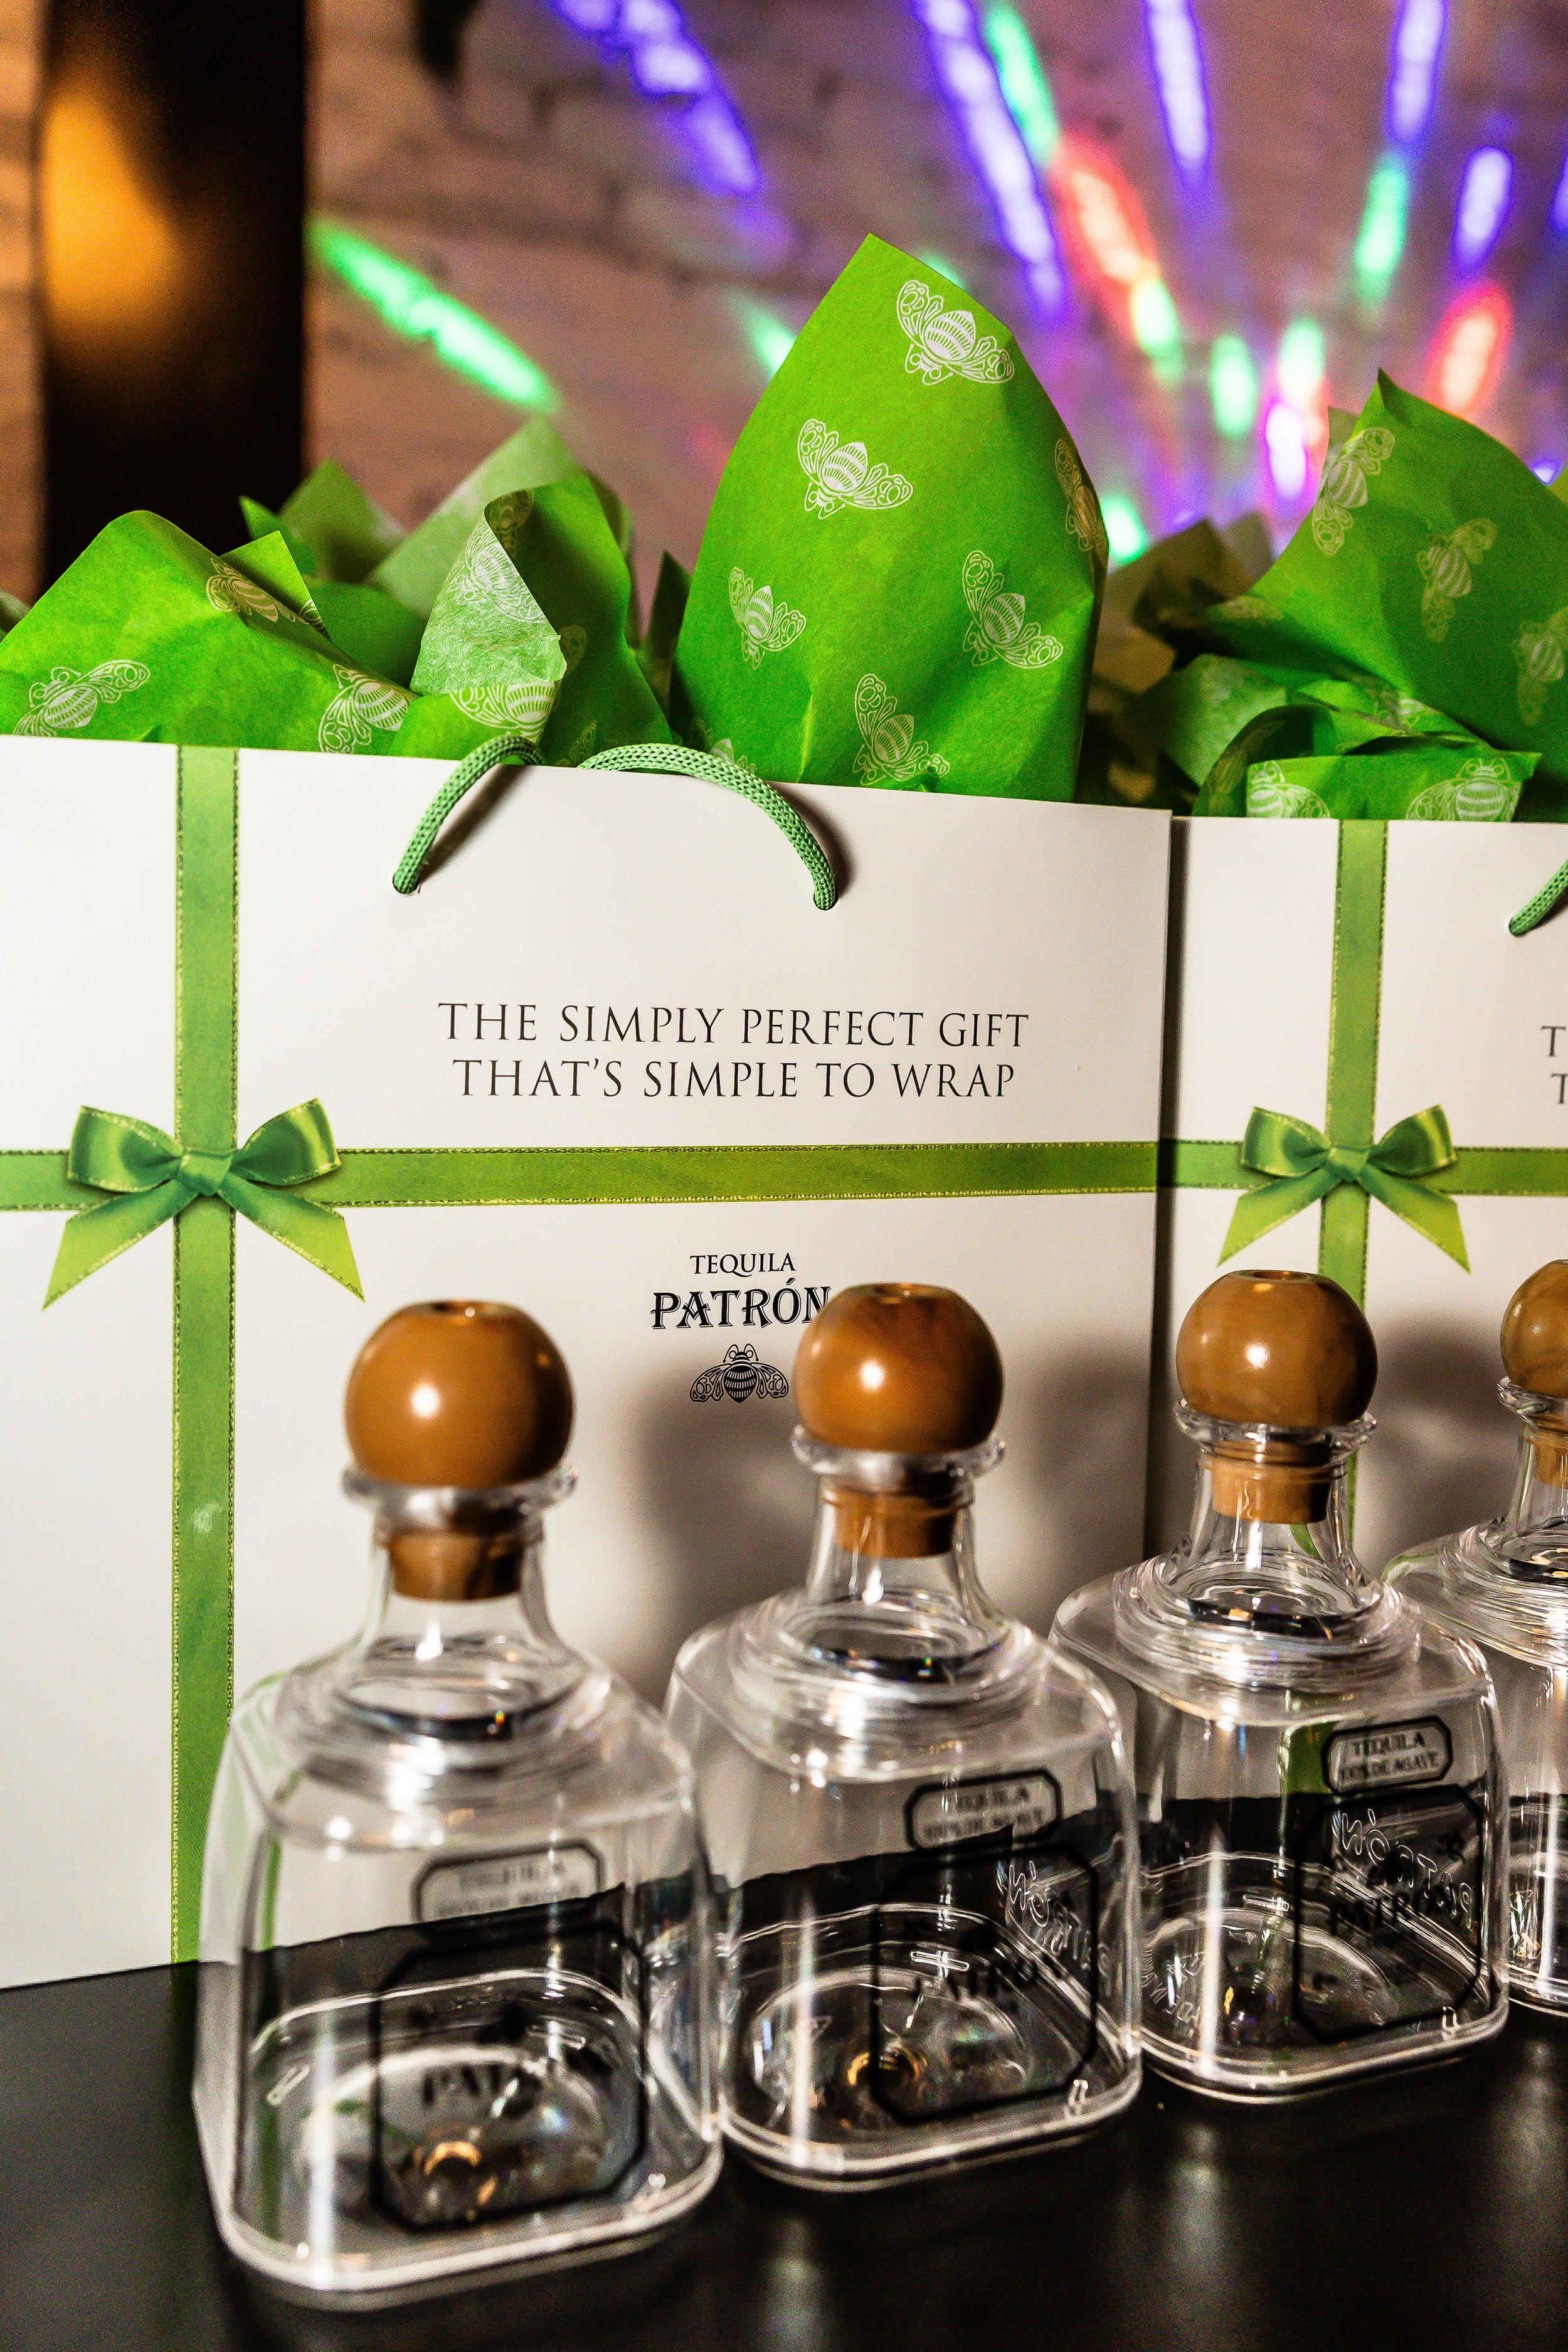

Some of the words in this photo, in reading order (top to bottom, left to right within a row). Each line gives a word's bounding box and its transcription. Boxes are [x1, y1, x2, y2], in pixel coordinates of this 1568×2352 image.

[437, 1002, 537, 1041] THE
[559, 1005, 725, 1044] SIMPLY
[741, 1009, 924, 1046] PERFECT
[939, 1012, 1029, 1047] GIFT
[452, 1057, 622, 1097] THAT'S
[644, 1061, 798, 1098] SIMPLE
[815, 1062, 875, 1098] TO
[890, 1063, 1014, 1098] WRAP
[689, 1252, 796, 1277] TEQUILA
